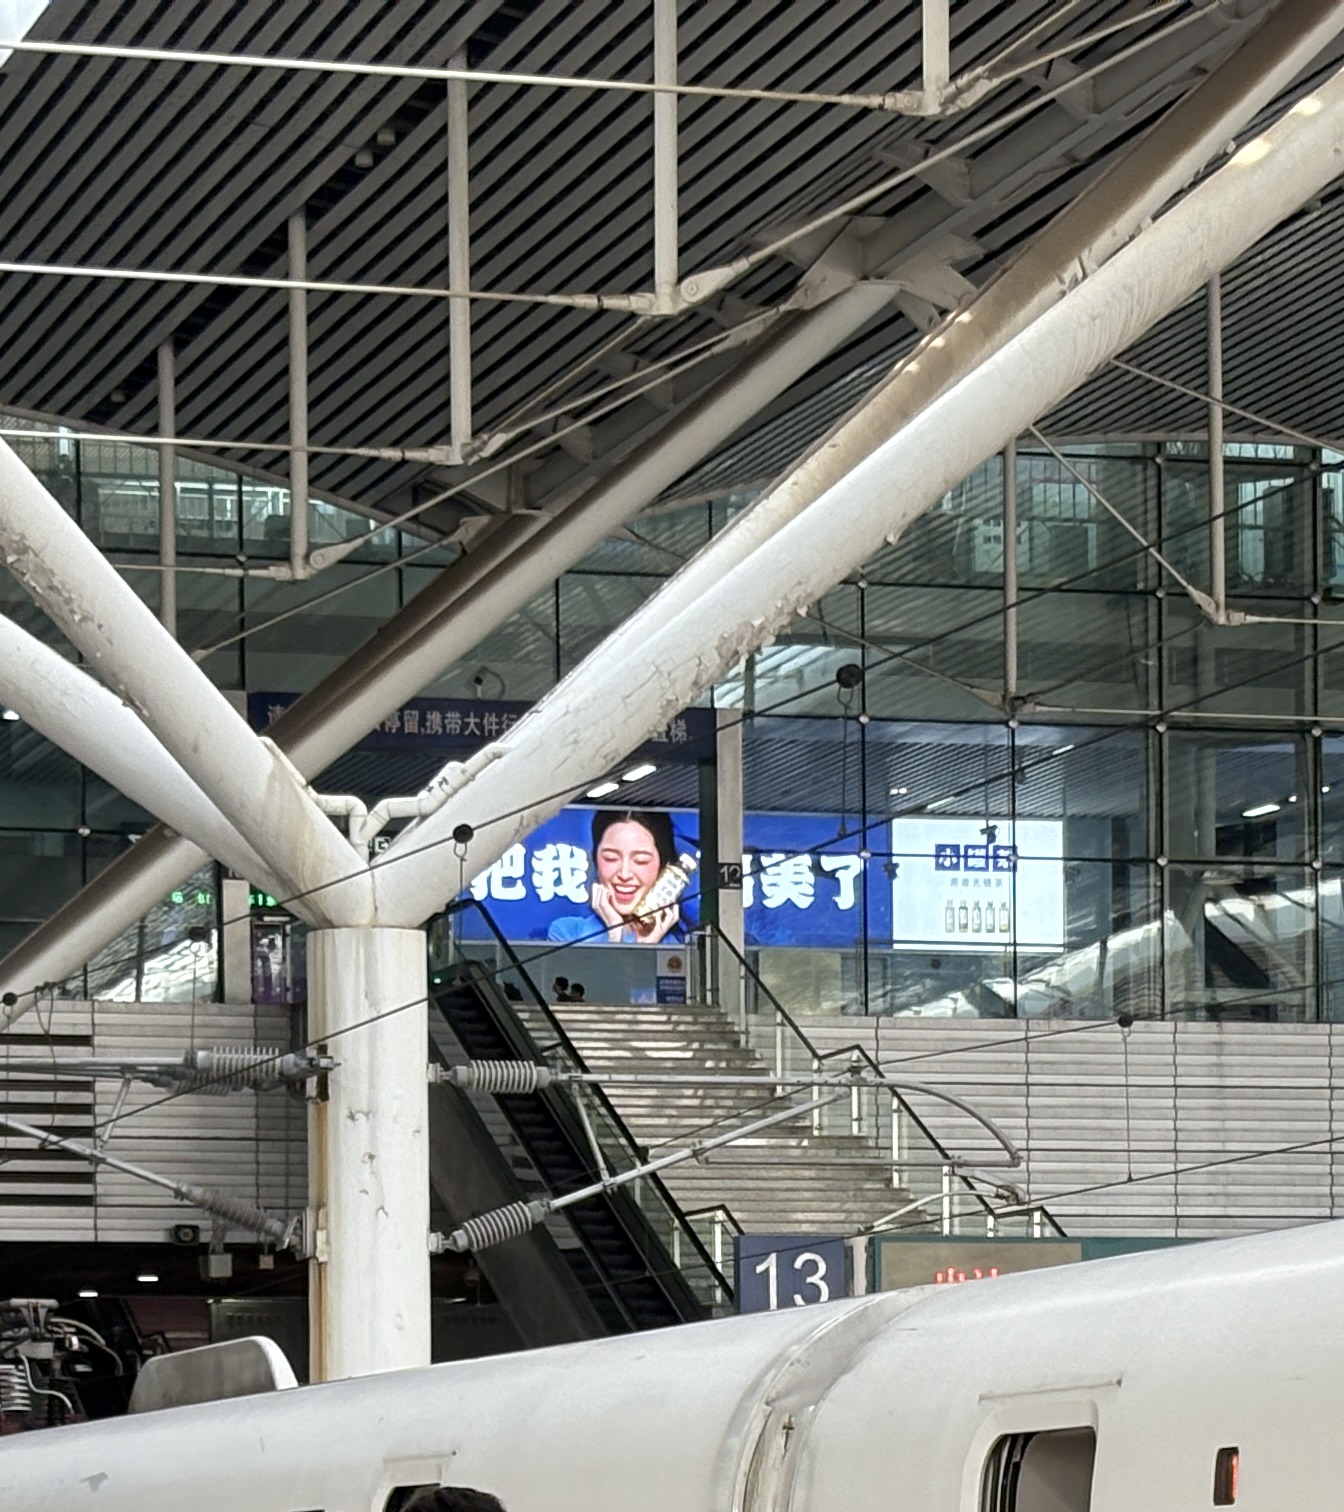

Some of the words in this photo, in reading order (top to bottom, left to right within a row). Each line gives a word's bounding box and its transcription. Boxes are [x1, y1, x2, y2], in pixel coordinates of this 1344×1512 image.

[471, 843, 590, 902] 把我
[742, 852, 864, 911] 美了
[756, 1252, 829, 1310] 13
